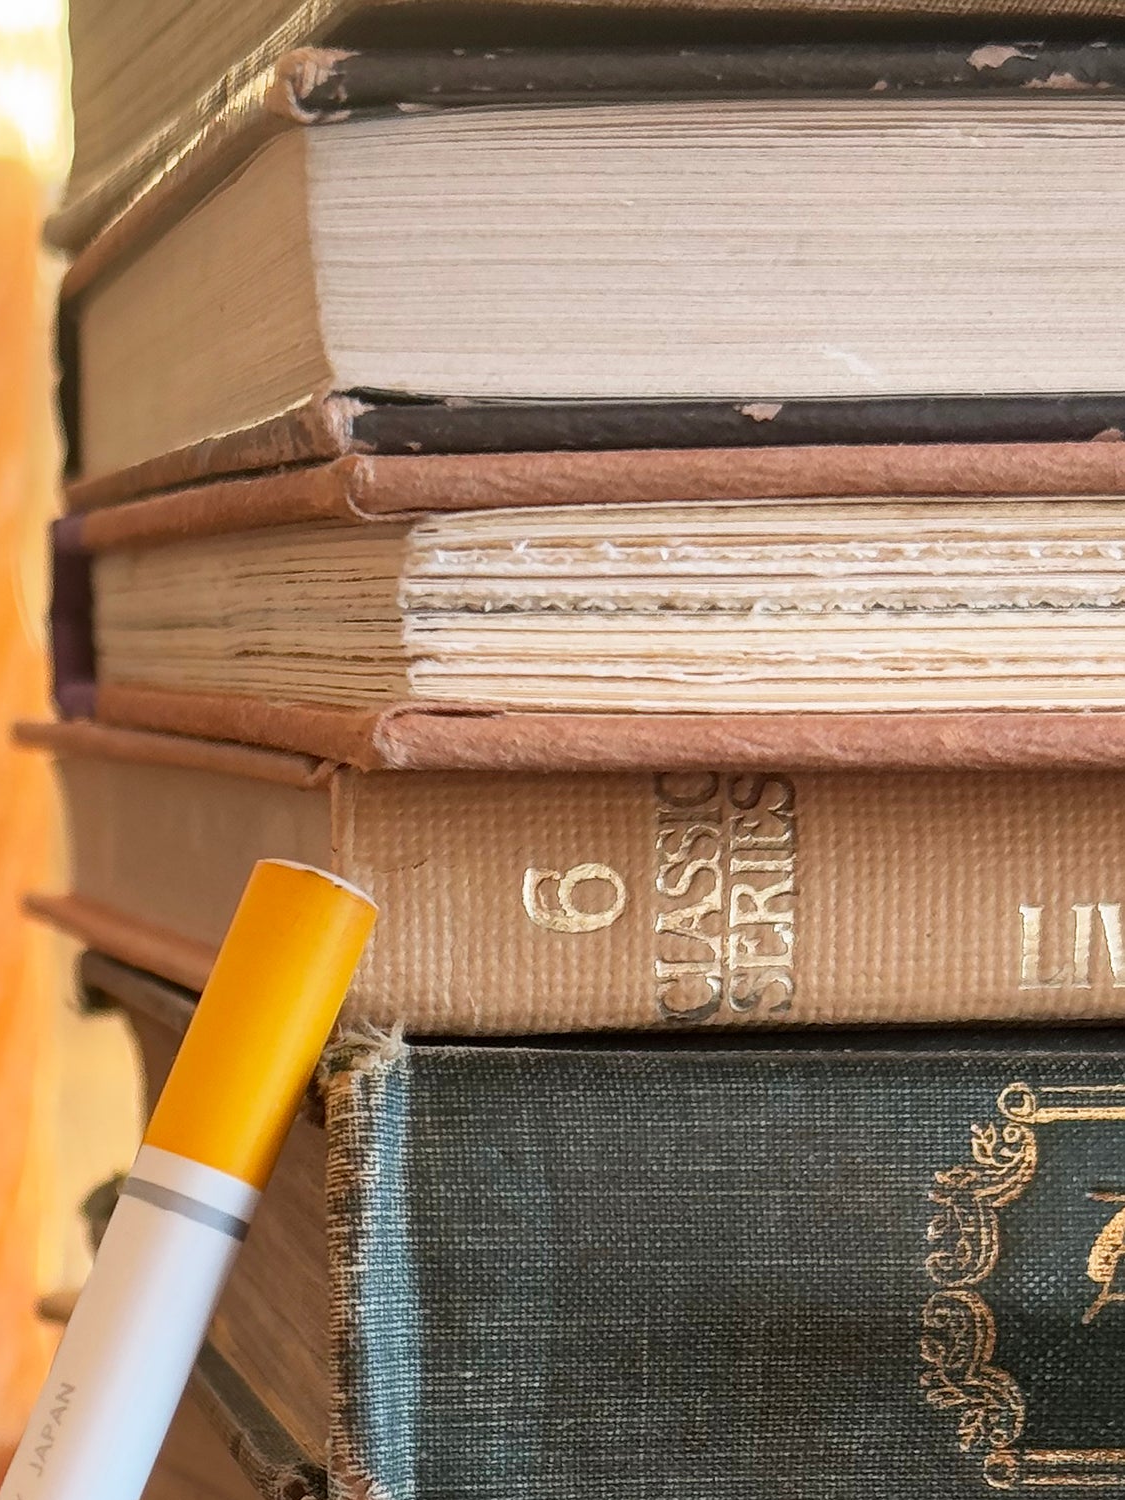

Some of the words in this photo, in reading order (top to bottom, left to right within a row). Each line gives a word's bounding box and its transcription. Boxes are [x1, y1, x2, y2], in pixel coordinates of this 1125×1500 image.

[653, 770, 723, 1022] CLASSIC
[728, 771, 797, 1014] SERIES
[29, 1381, 76, 1477] JAPAN
